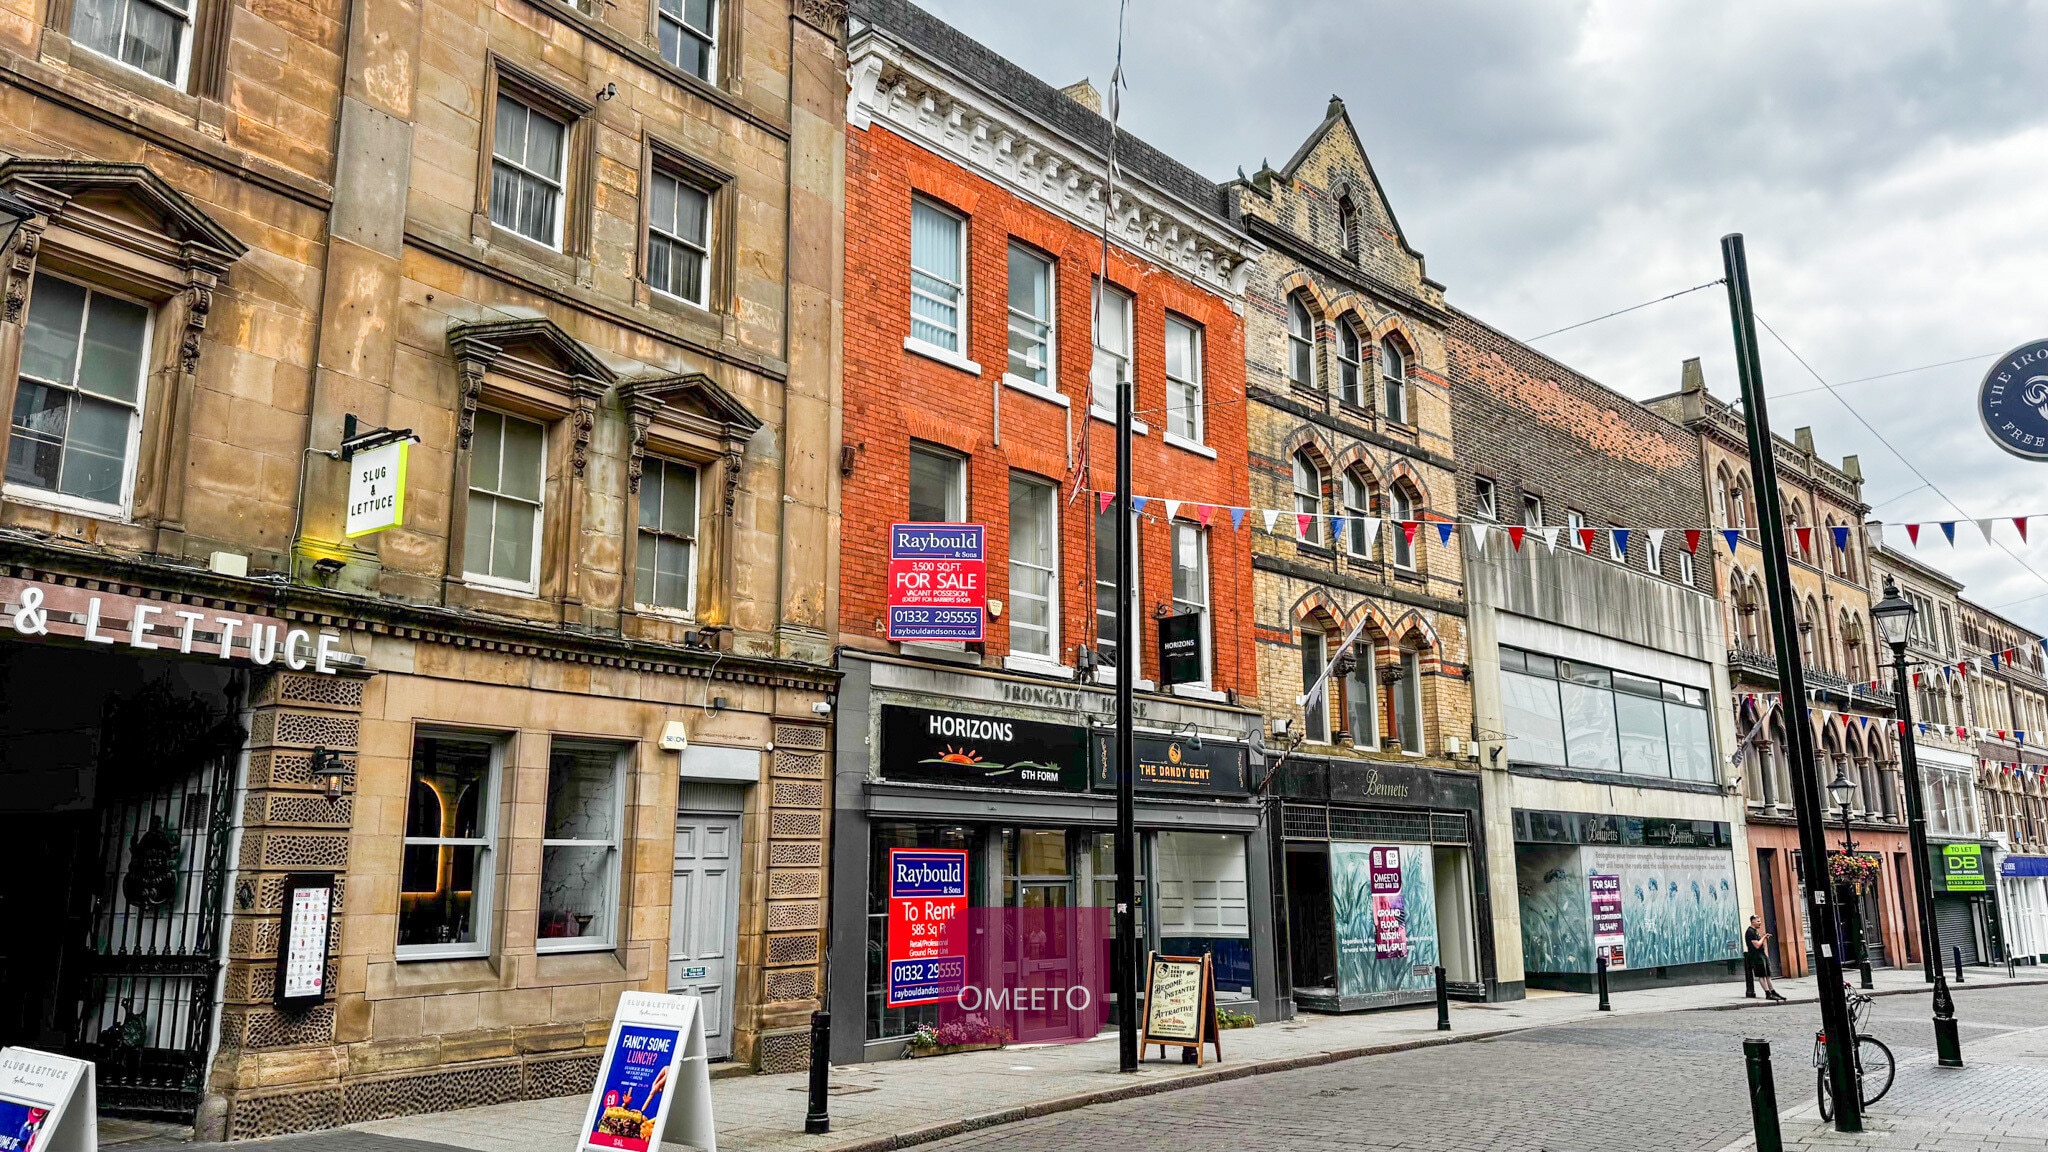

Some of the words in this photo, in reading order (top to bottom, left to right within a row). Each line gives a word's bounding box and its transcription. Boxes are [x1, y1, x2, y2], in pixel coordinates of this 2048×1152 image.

[1990, 371, 2012, 408] THE
[2002, 421, 2046, 447] FREE
[362, 466, 386, 483] SLUG
[370, 484, 376, 496] &
[351, 495, 393, 516] LETTUCE
[898, 532, 978, 552] Raybould
[912, 562, 934, 572] 3,500
[896, 572, 930, 588] FOR
[936, 574, 977, 590] SALE
[895, 610, 929, 622] 01332
[935, 611, 977, 623] 295555
[13, 586, 48, 636] &
[84, 596, 340, 675] LETTUCE
[895, 628, 976, 636] raybouldandsons.co.uk
[1164, 640, 1195, 650] HORIZONS
[1004, 684, 1082, 710] IRONGATE
[1102, 697, 1148, 718] HOSE
[929, 715, 1013, 742] HORIZONS
[1021, 769, 1036, 781] 6TH
[1038, 770, 1059, 782] FORM
[1140, 764, 1156, 776] THE
[1160, 766, 1186, 778] DANDY
[1190, 768, 1210, 780] GENT
[1362, 768, 1408, 798] Bennetts
[1587, 818, 1618, 842] Bennetts
[1669, 823, 1694, 844] Bennetts
[897, 863, 961, 887] Raybould
[1374, 873, 1399, 883] OMEETO
[1592, 880, 1603, 889] FOR
[1604, 880, 1617, 889] SALE
[902, 902, 918, 921] To
[925, 901, 956, 921] Rent
[1377, 908, 1400, 917] GROUND
[911, 924, 925, 936] 585
[927, 924, 938, 937] Sq
[939, 922, 946, 934] Ft
[1380, 920, 1399, 929] FLOOR
[909, 939, 949, 948] Retail/Professional
[1376, 943, 1390, 953] WILL
[1390, 942, 1406, 952] SPLIT
[909, 949, 926, 957] Ground
[927, 948, 938, 956] Floor
[894, 964, 923, 982] 01332
[928, 961, 961, 979] 295555
[894, 984, 960, 1000] raybouldandsons.co.uk
[1154, 979, 1183, 994] BECOME
[1164, 985, 1196, 999] INSTANTLY
[1154, 1006, 1194, 1019] ATTRACTIVE
[622, 1034, 649, 1051] FANCY
[648, 1038, 671, 1053] SOME
[627, 1050, 658, 1066] LUNCH?
[607, 1094, 615, 1106] £8
